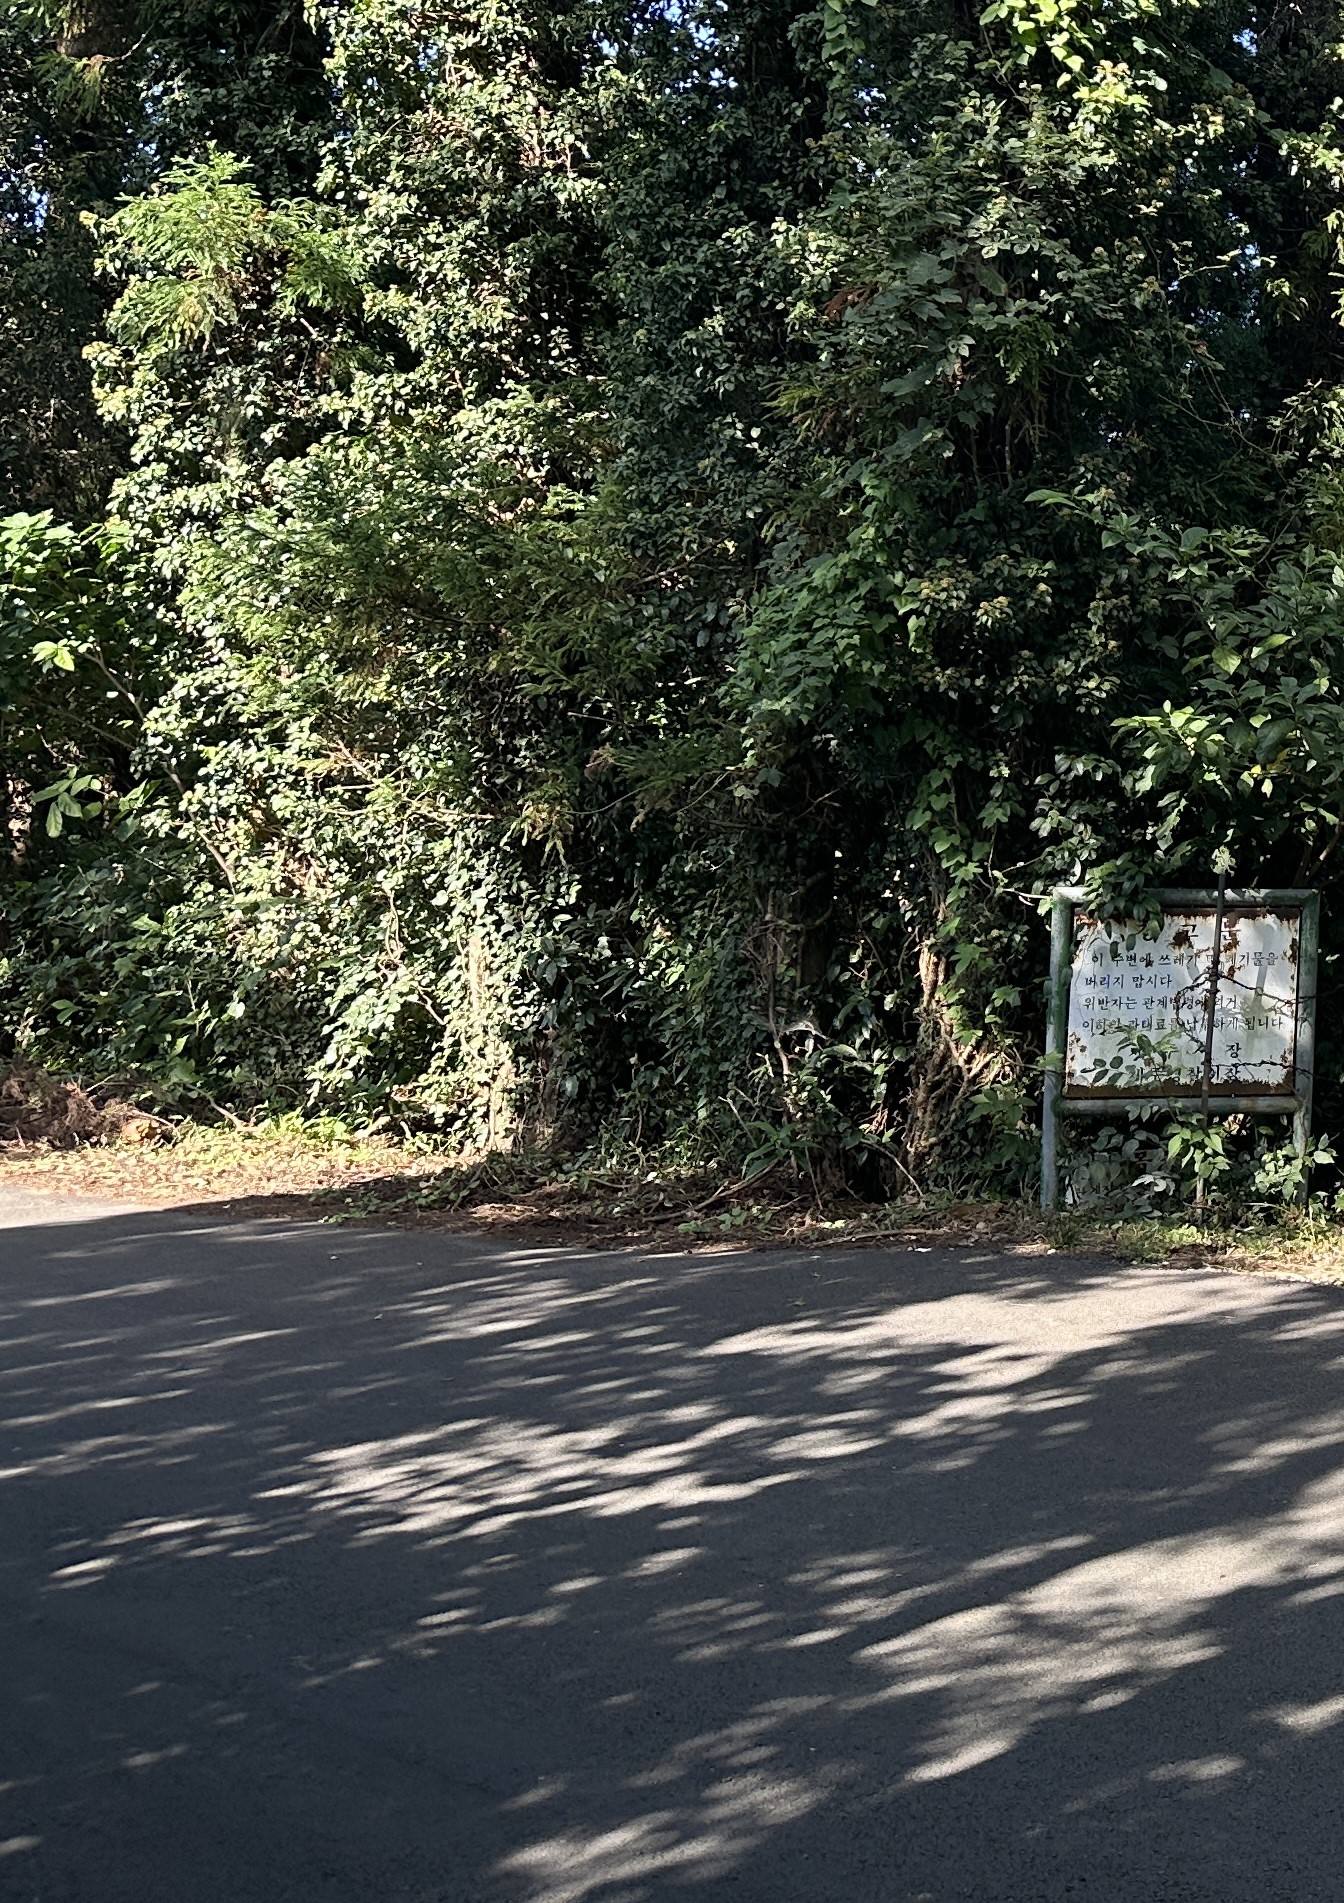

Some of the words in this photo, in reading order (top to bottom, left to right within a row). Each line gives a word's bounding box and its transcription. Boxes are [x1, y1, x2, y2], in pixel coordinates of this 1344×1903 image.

[1091, 952, 1103, 967] 이
[1158, 952, 1197, 967] 쓰레기
[1085, 973, 1124, 989] 버리지
[1132, 973, 1172, 989] 맙시다
[1083, 995, 1137, 1010] 위반자는
[1244, 1016, 1284, 1031] 됩니다
